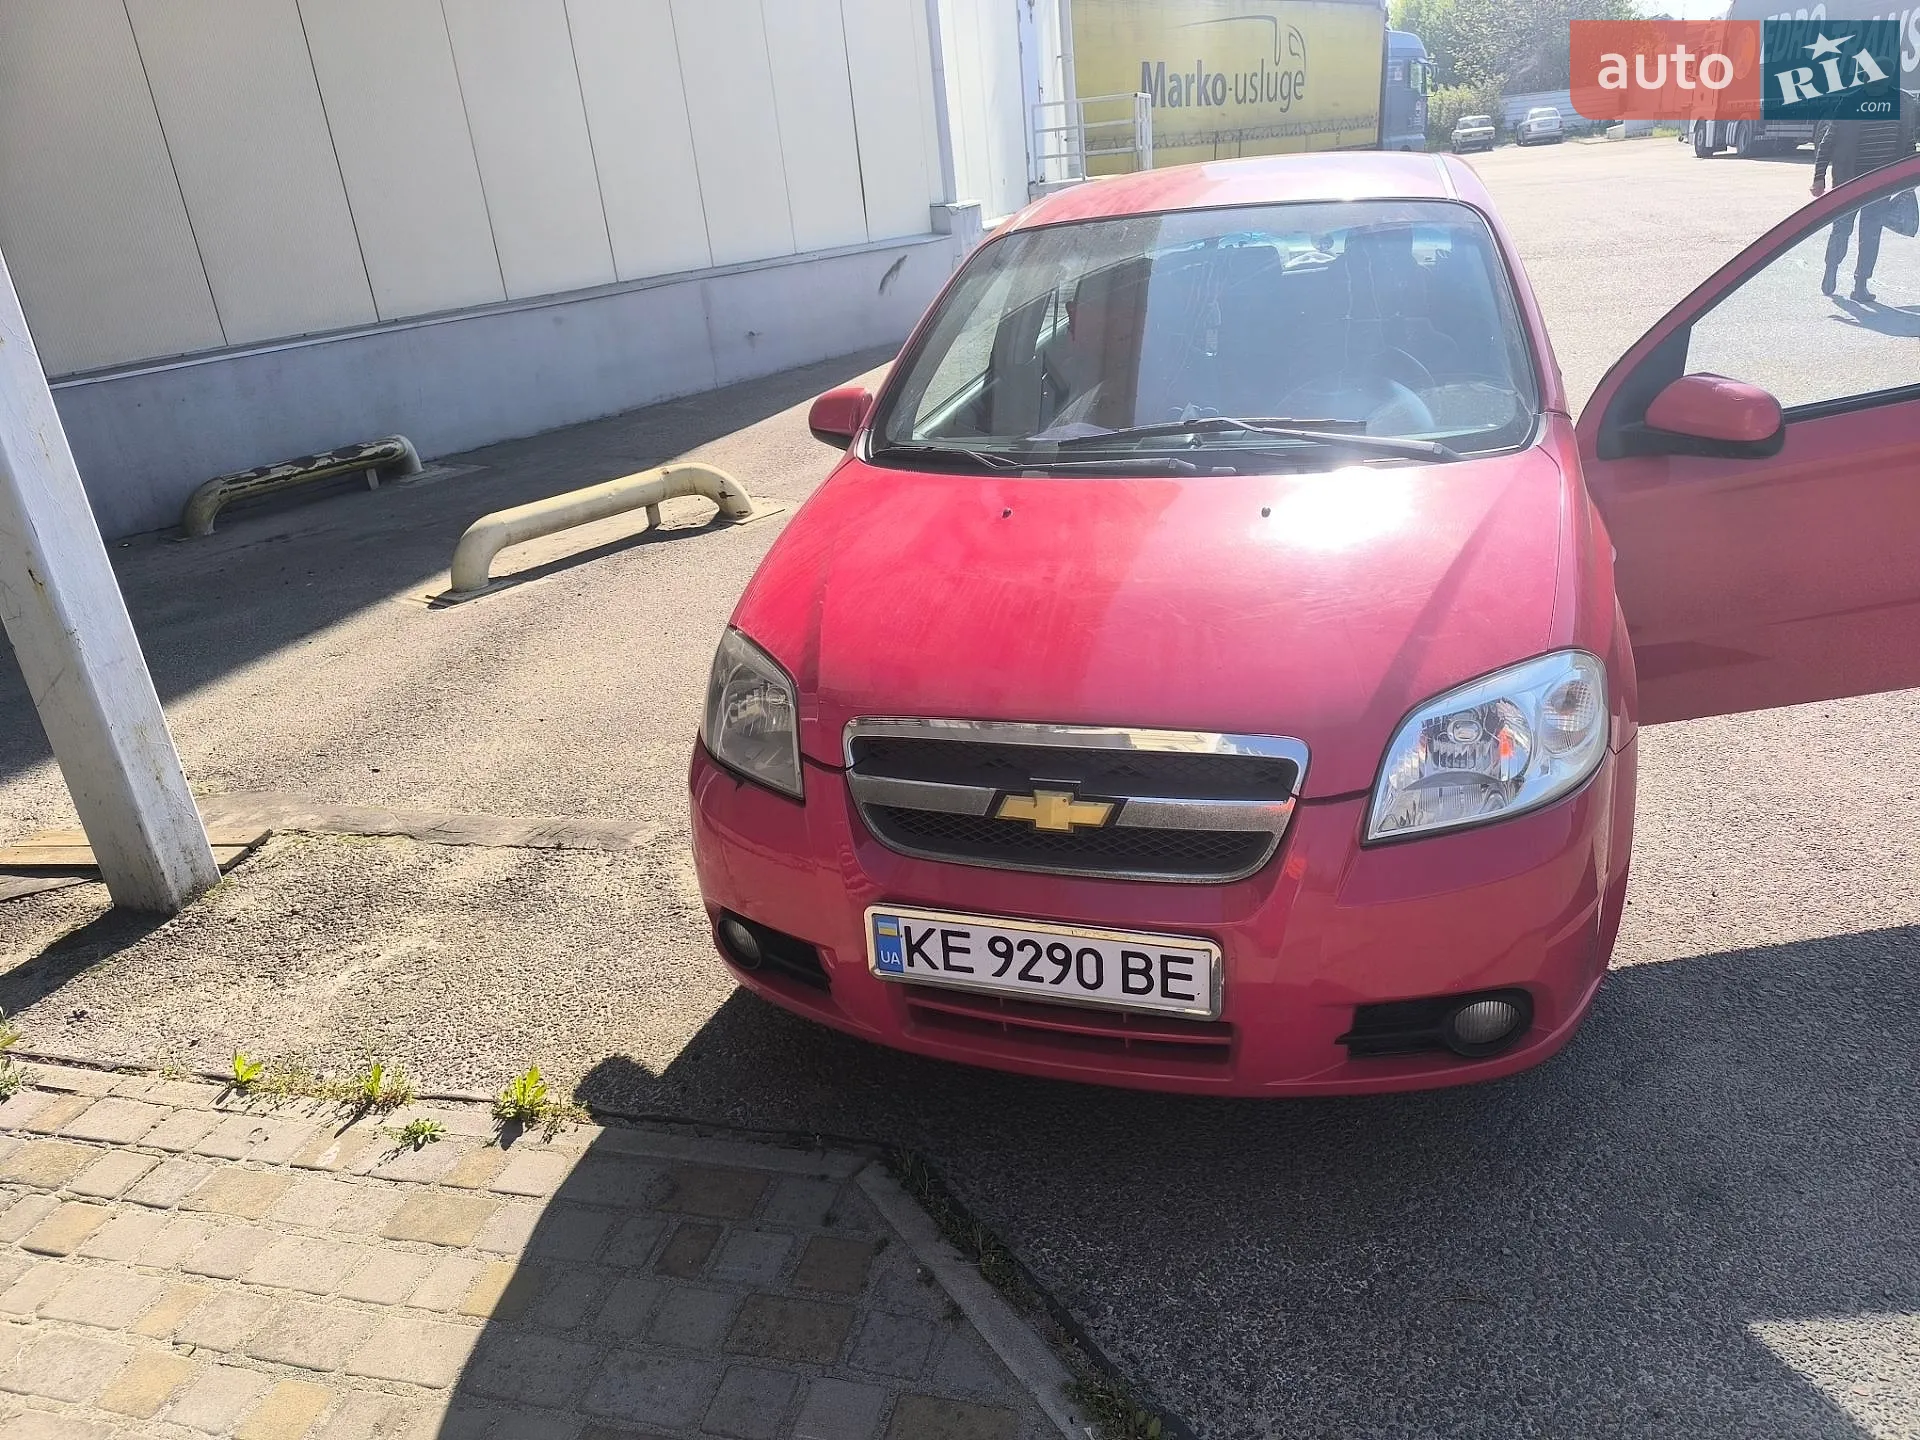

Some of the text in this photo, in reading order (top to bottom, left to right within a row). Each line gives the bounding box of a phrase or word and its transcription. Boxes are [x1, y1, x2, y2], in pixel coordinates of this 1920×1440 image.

[1142, 58, 1305, 113] Marko-usluge
[881, 950, 901, 965] UA
[904, 925, 1196, 1002] KE 9290 BE
